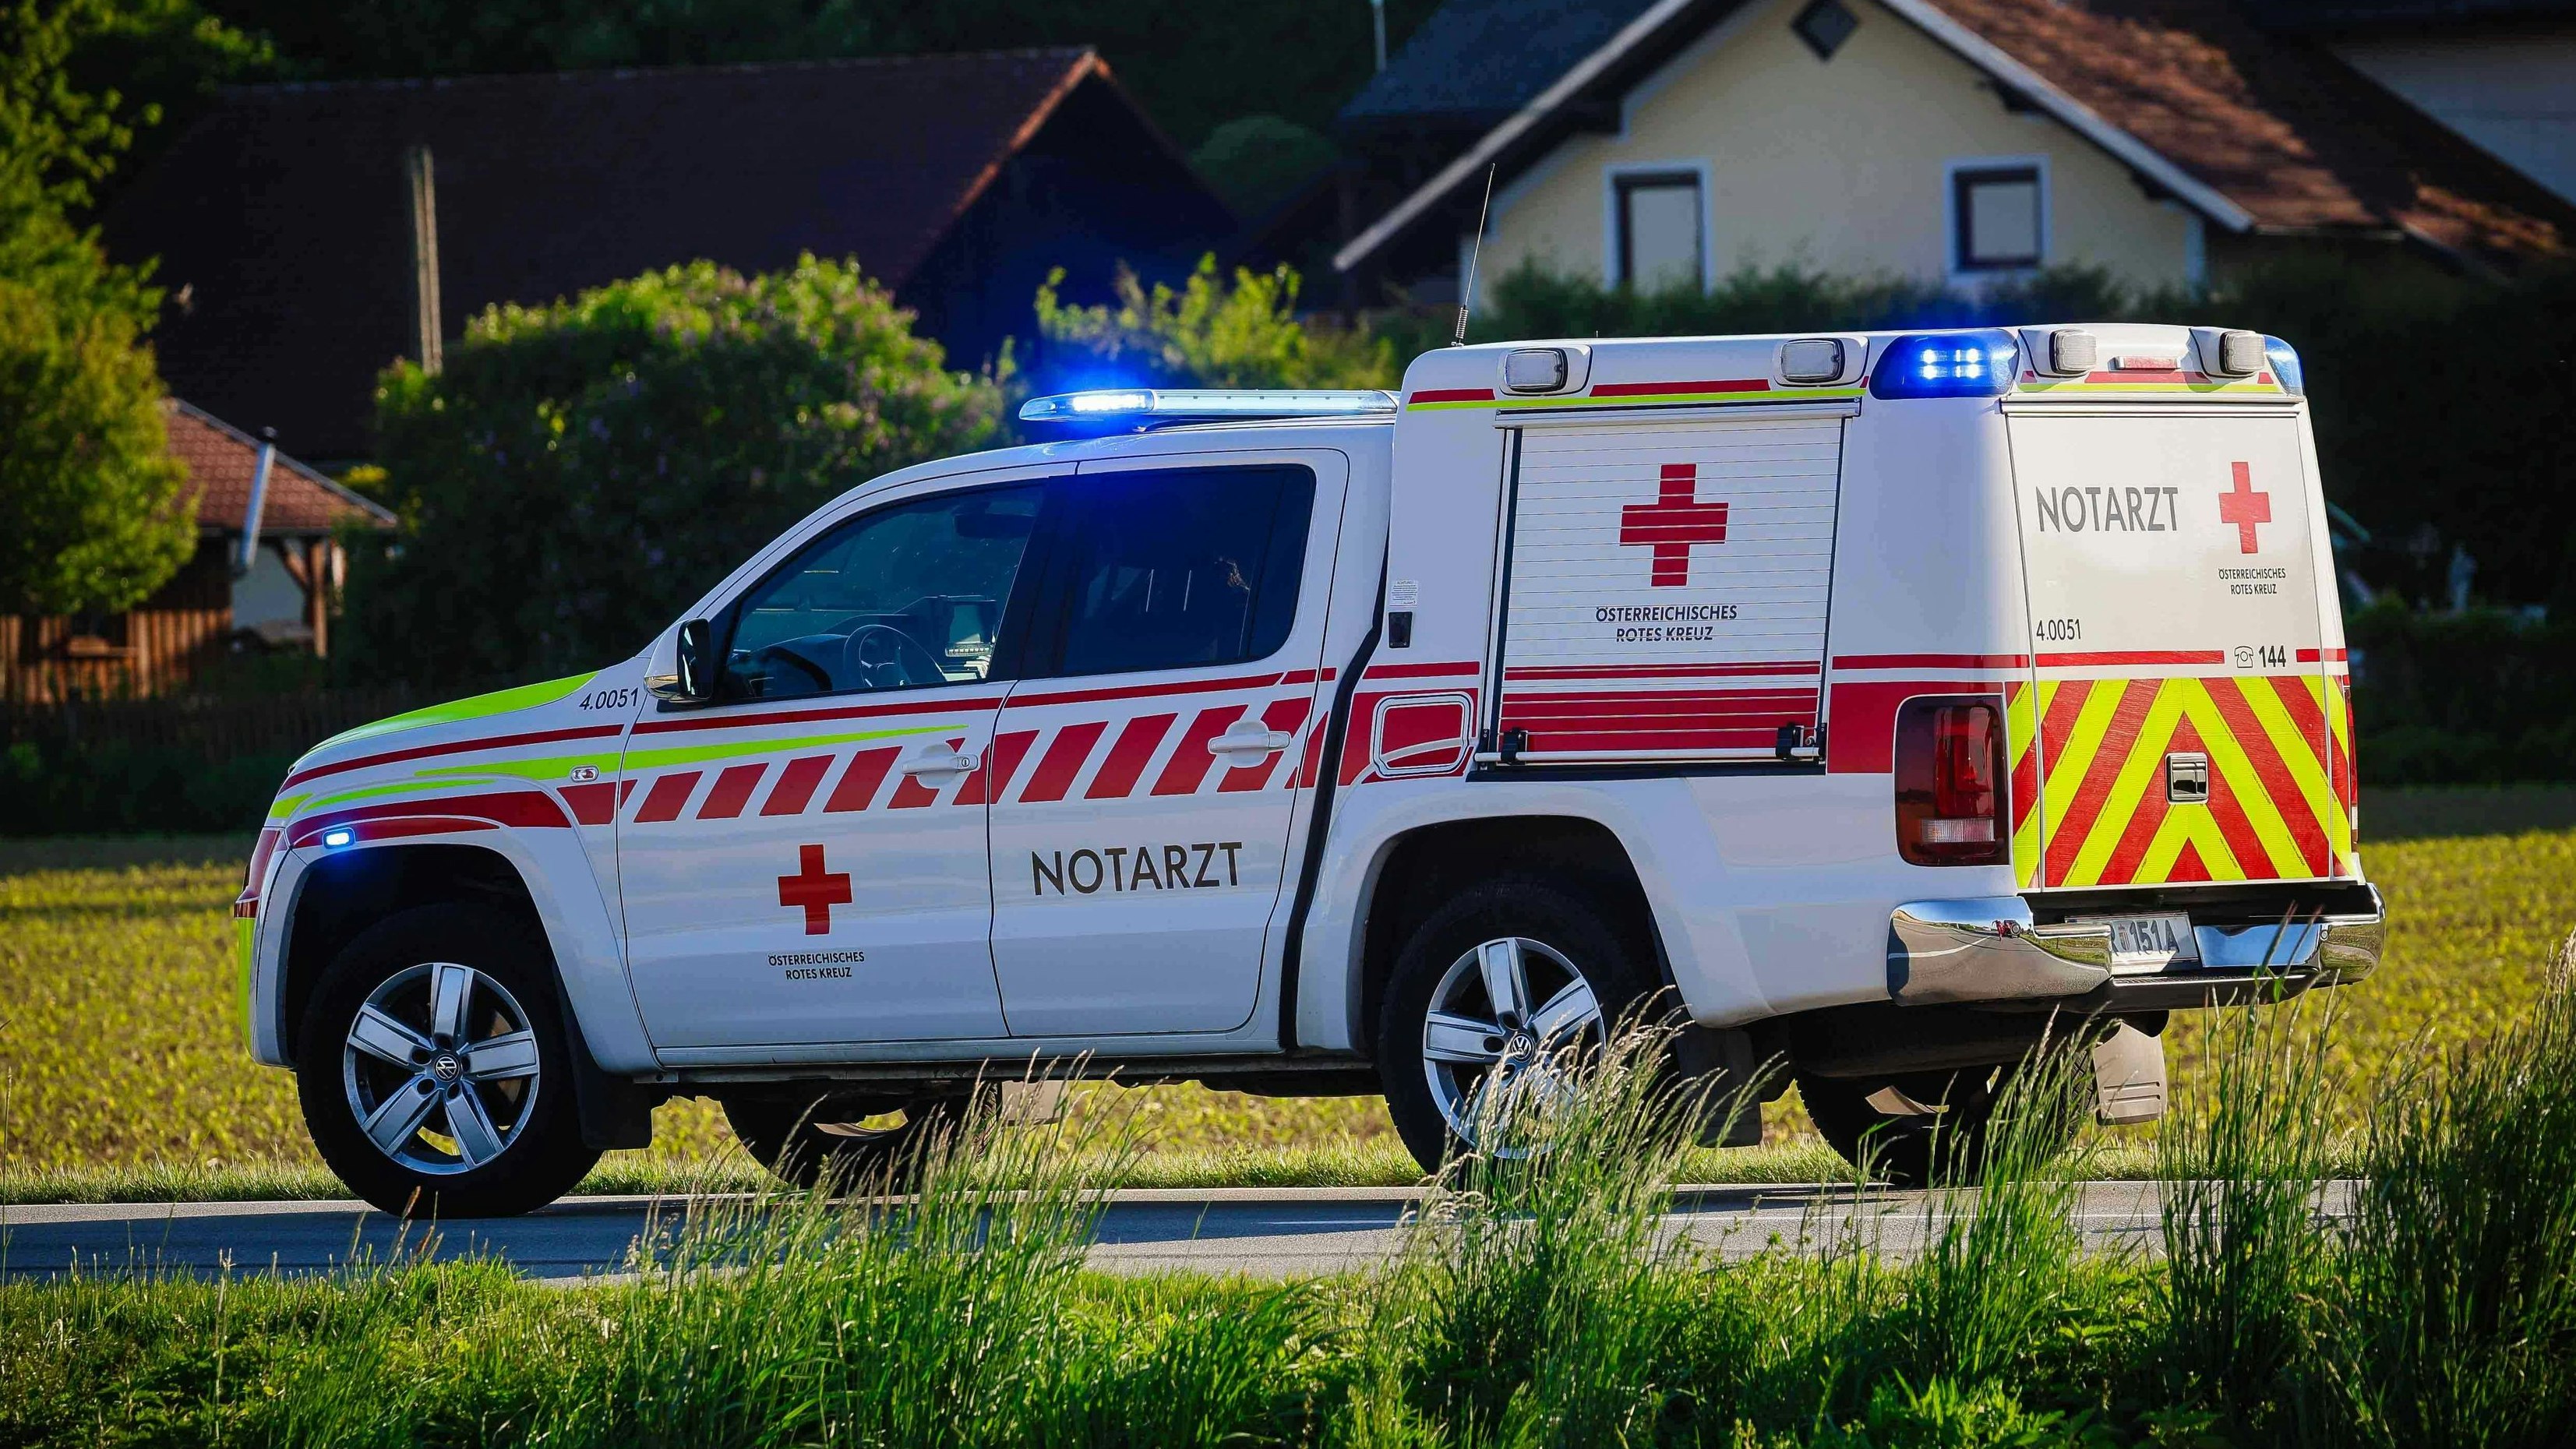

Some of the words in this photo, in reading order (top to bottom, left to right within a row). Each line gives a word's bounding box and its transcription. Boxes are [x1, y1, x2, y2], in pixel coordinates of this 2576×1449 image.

[2035, 485, 2179, 533] NOTARZT
[2218, 567, 2286, 580] ÖSTERREICHISCHES
[2230, 583, 2253, 594] ROTES
[2254, 583, 2278, 594] KREUZ
[1595, 605, 1738, 622] ÖSTERREICHISCHES
[1616, 627, 1662, 642] ROTES
[1666, 626, 1713, 641] KREUZ
[2036, 619, 2081, 640] 4.0051
[2258, 645, 2287, 668] 144
[579, 687, 638, 710] 4.0051
[1031, 841, 1243, 896] NOTARZT
[2129, 919, 2180, 955] 151A
[768, 951, 865, 966] ÖSTERREICHISCHES
[785, 968, 818, 980] ROTES
[819, 967, 852, 978] KREUZ
